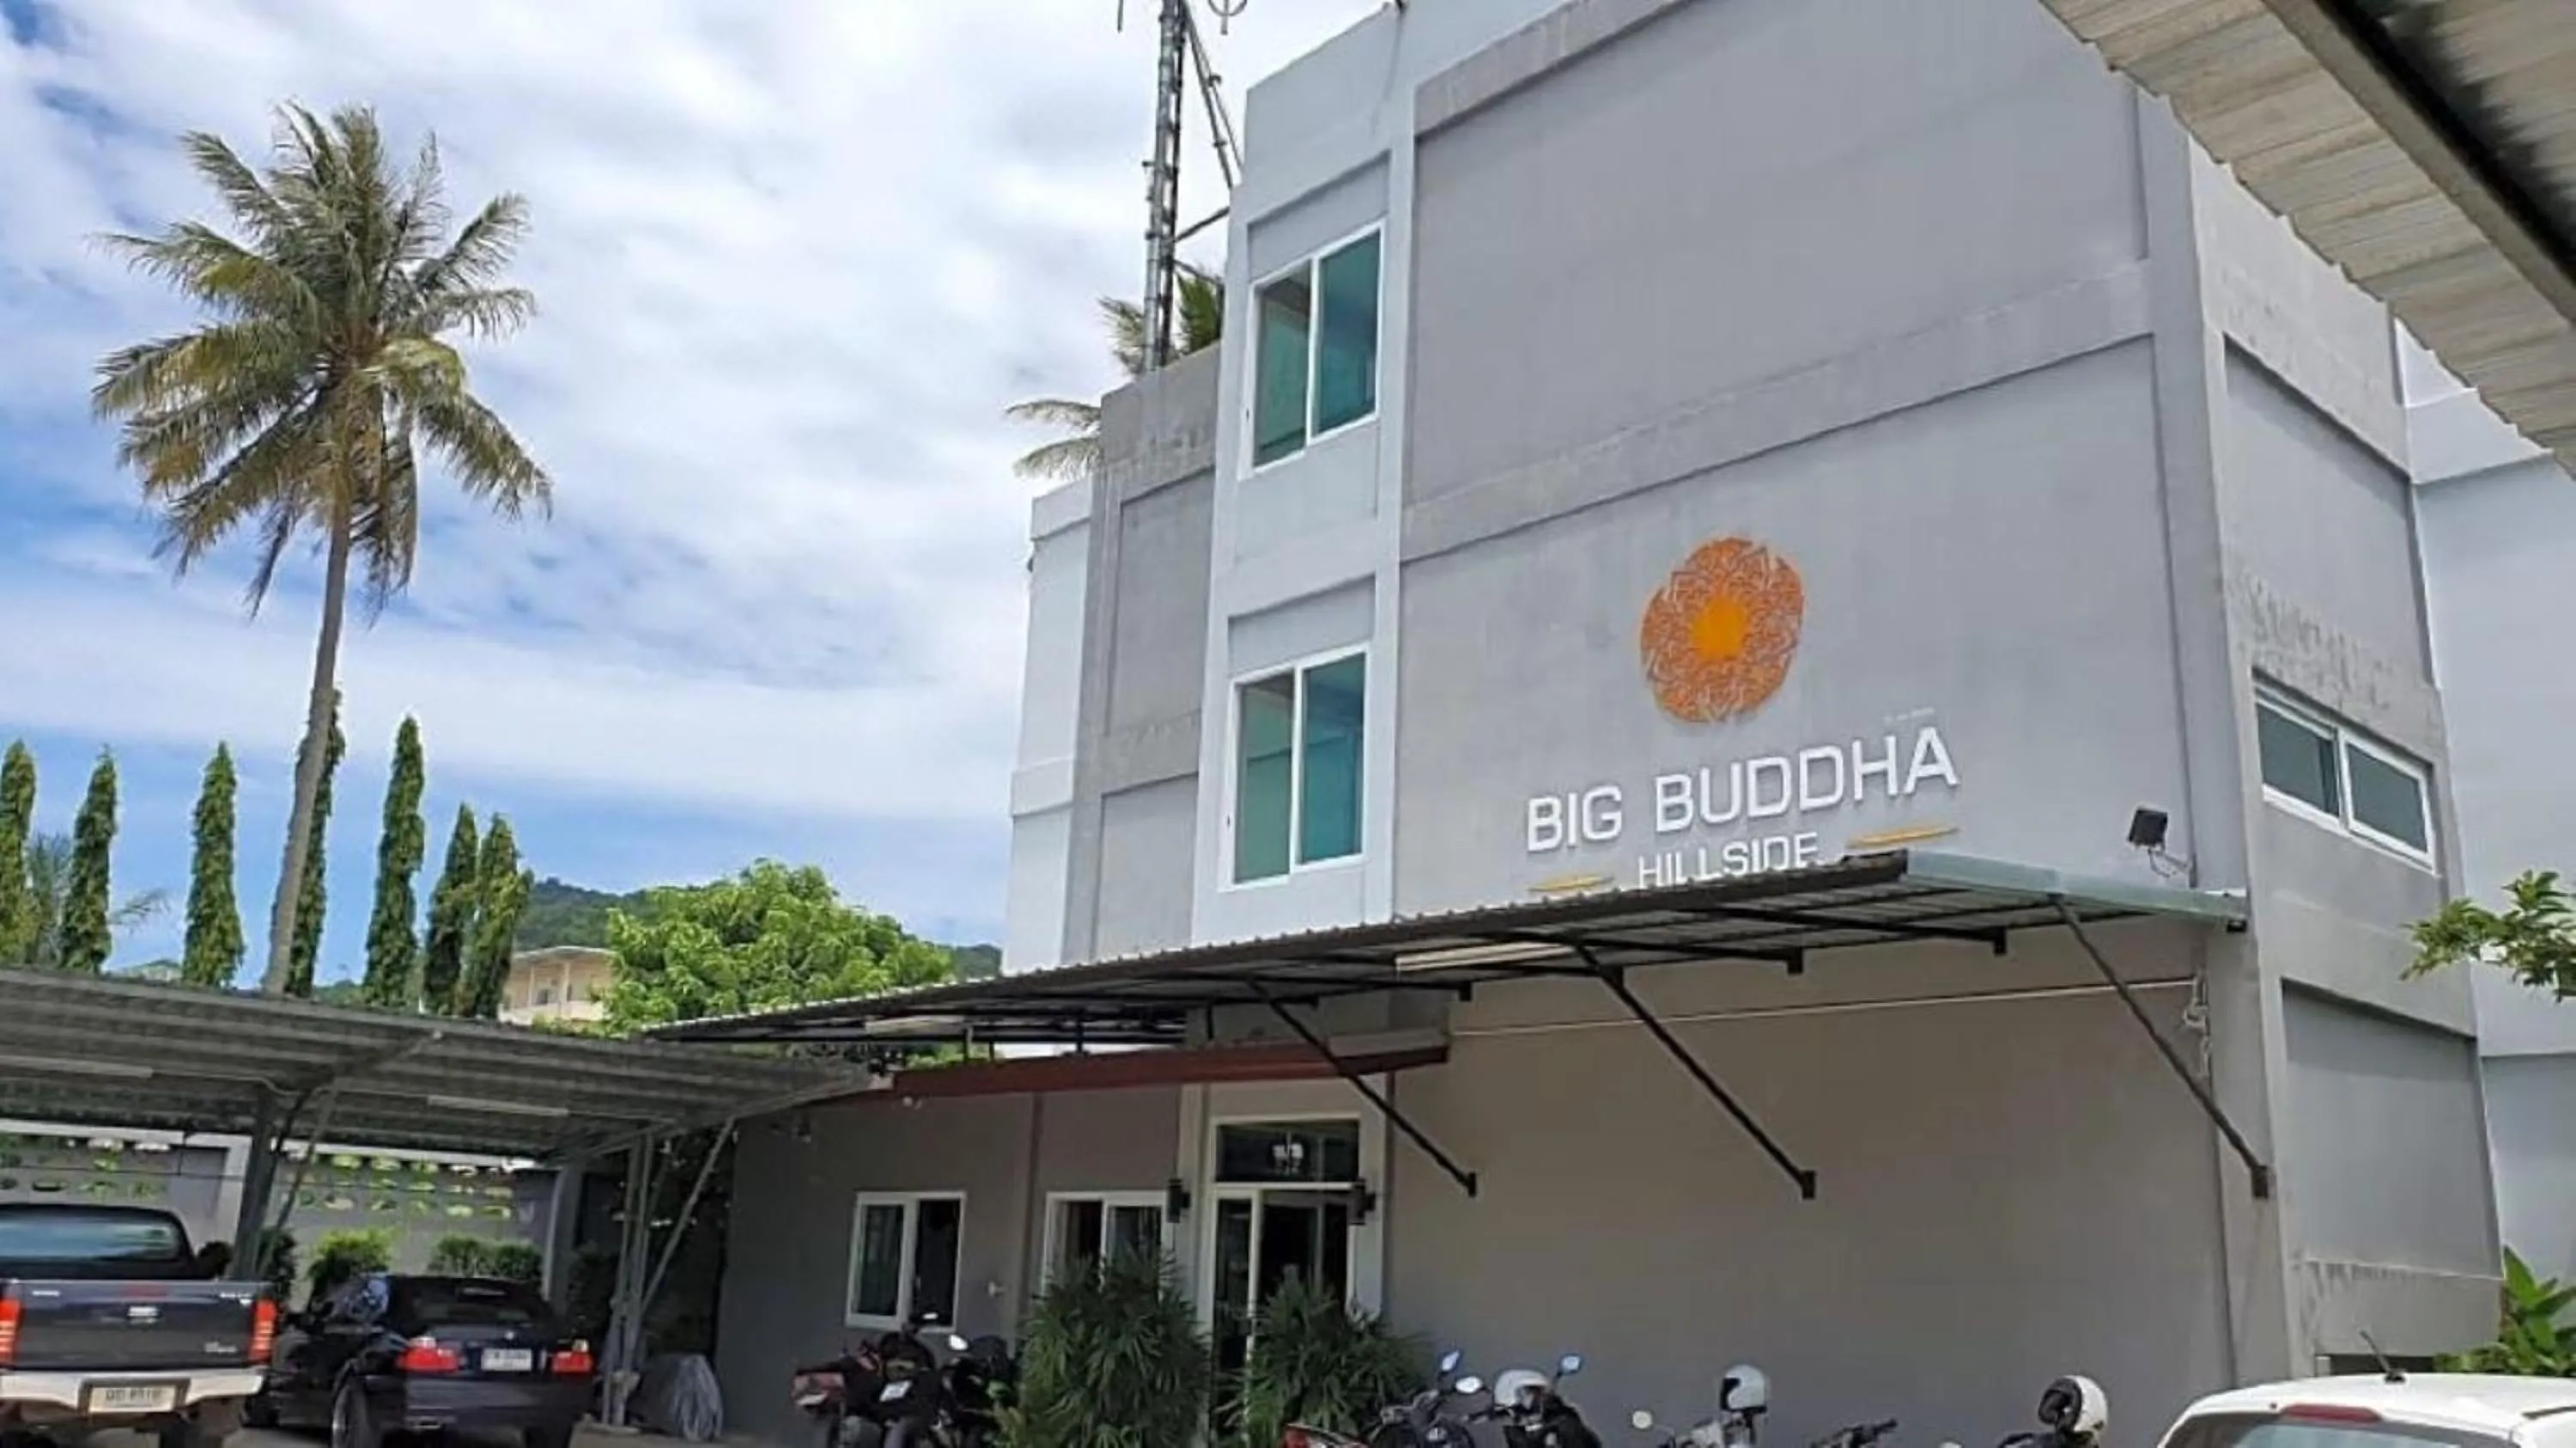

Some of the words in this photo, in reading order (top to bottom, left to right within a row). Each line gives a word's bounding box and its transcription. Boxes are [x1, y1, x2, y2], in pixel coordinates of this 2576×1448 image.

[1528, 785, 1622, 852] BIG
[1656, 727, 1959, 833] BUDDHA
[1638, 831, 1820, 889] HILLSIDE
